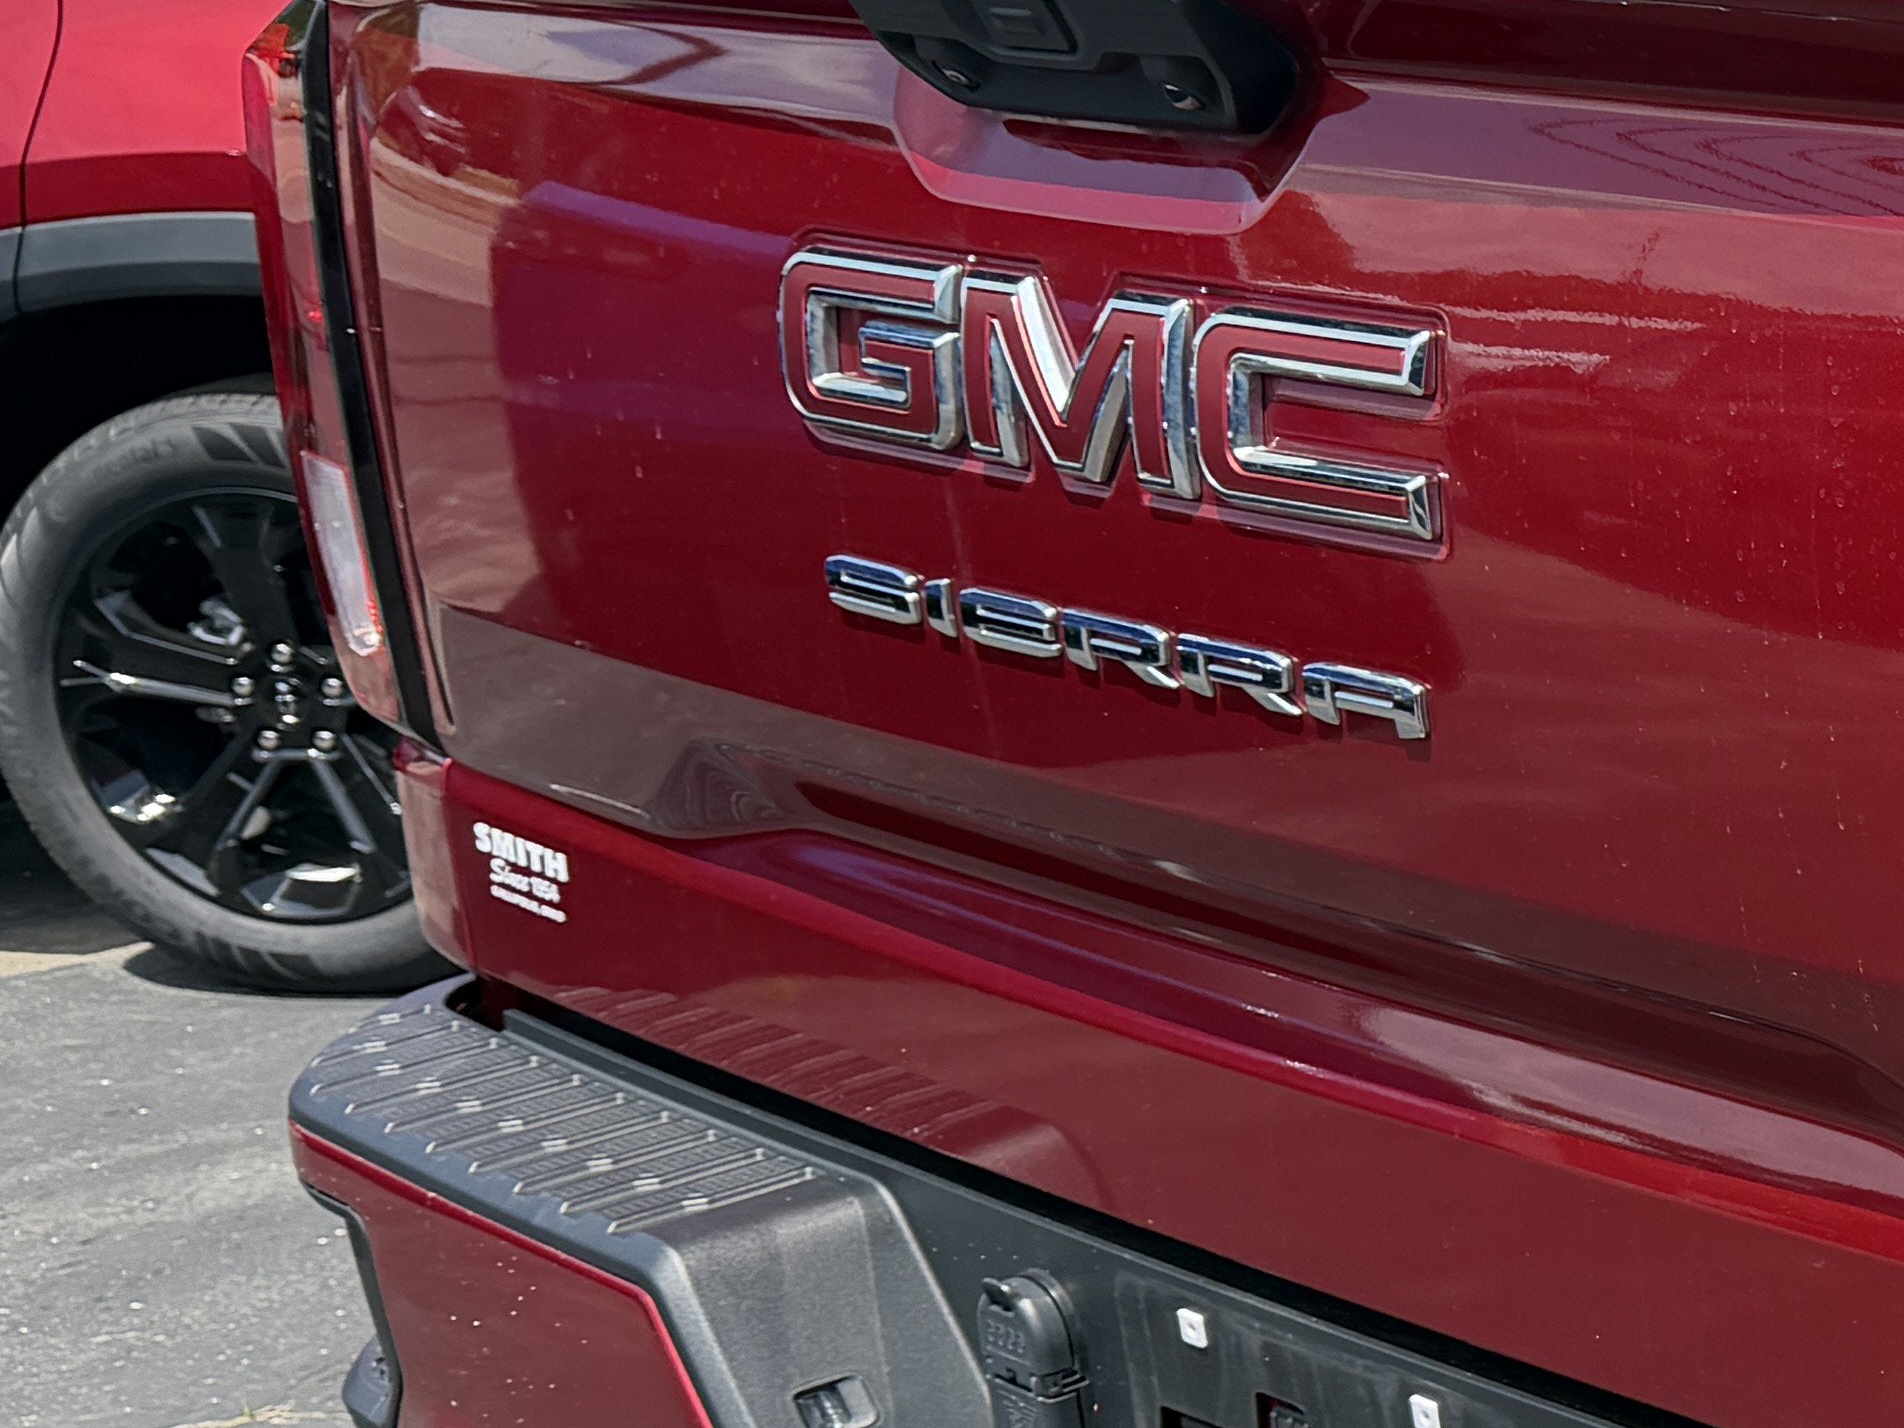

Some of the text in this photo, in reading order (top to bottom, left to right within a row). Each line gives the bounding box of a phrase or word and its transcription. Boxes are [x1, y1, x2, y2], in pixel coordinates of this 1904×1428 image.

[778, 242, 1445, 550] GMC
[824, 553, 1432, 740] SIERRA
[473, 821, 570, 883] SMITH
